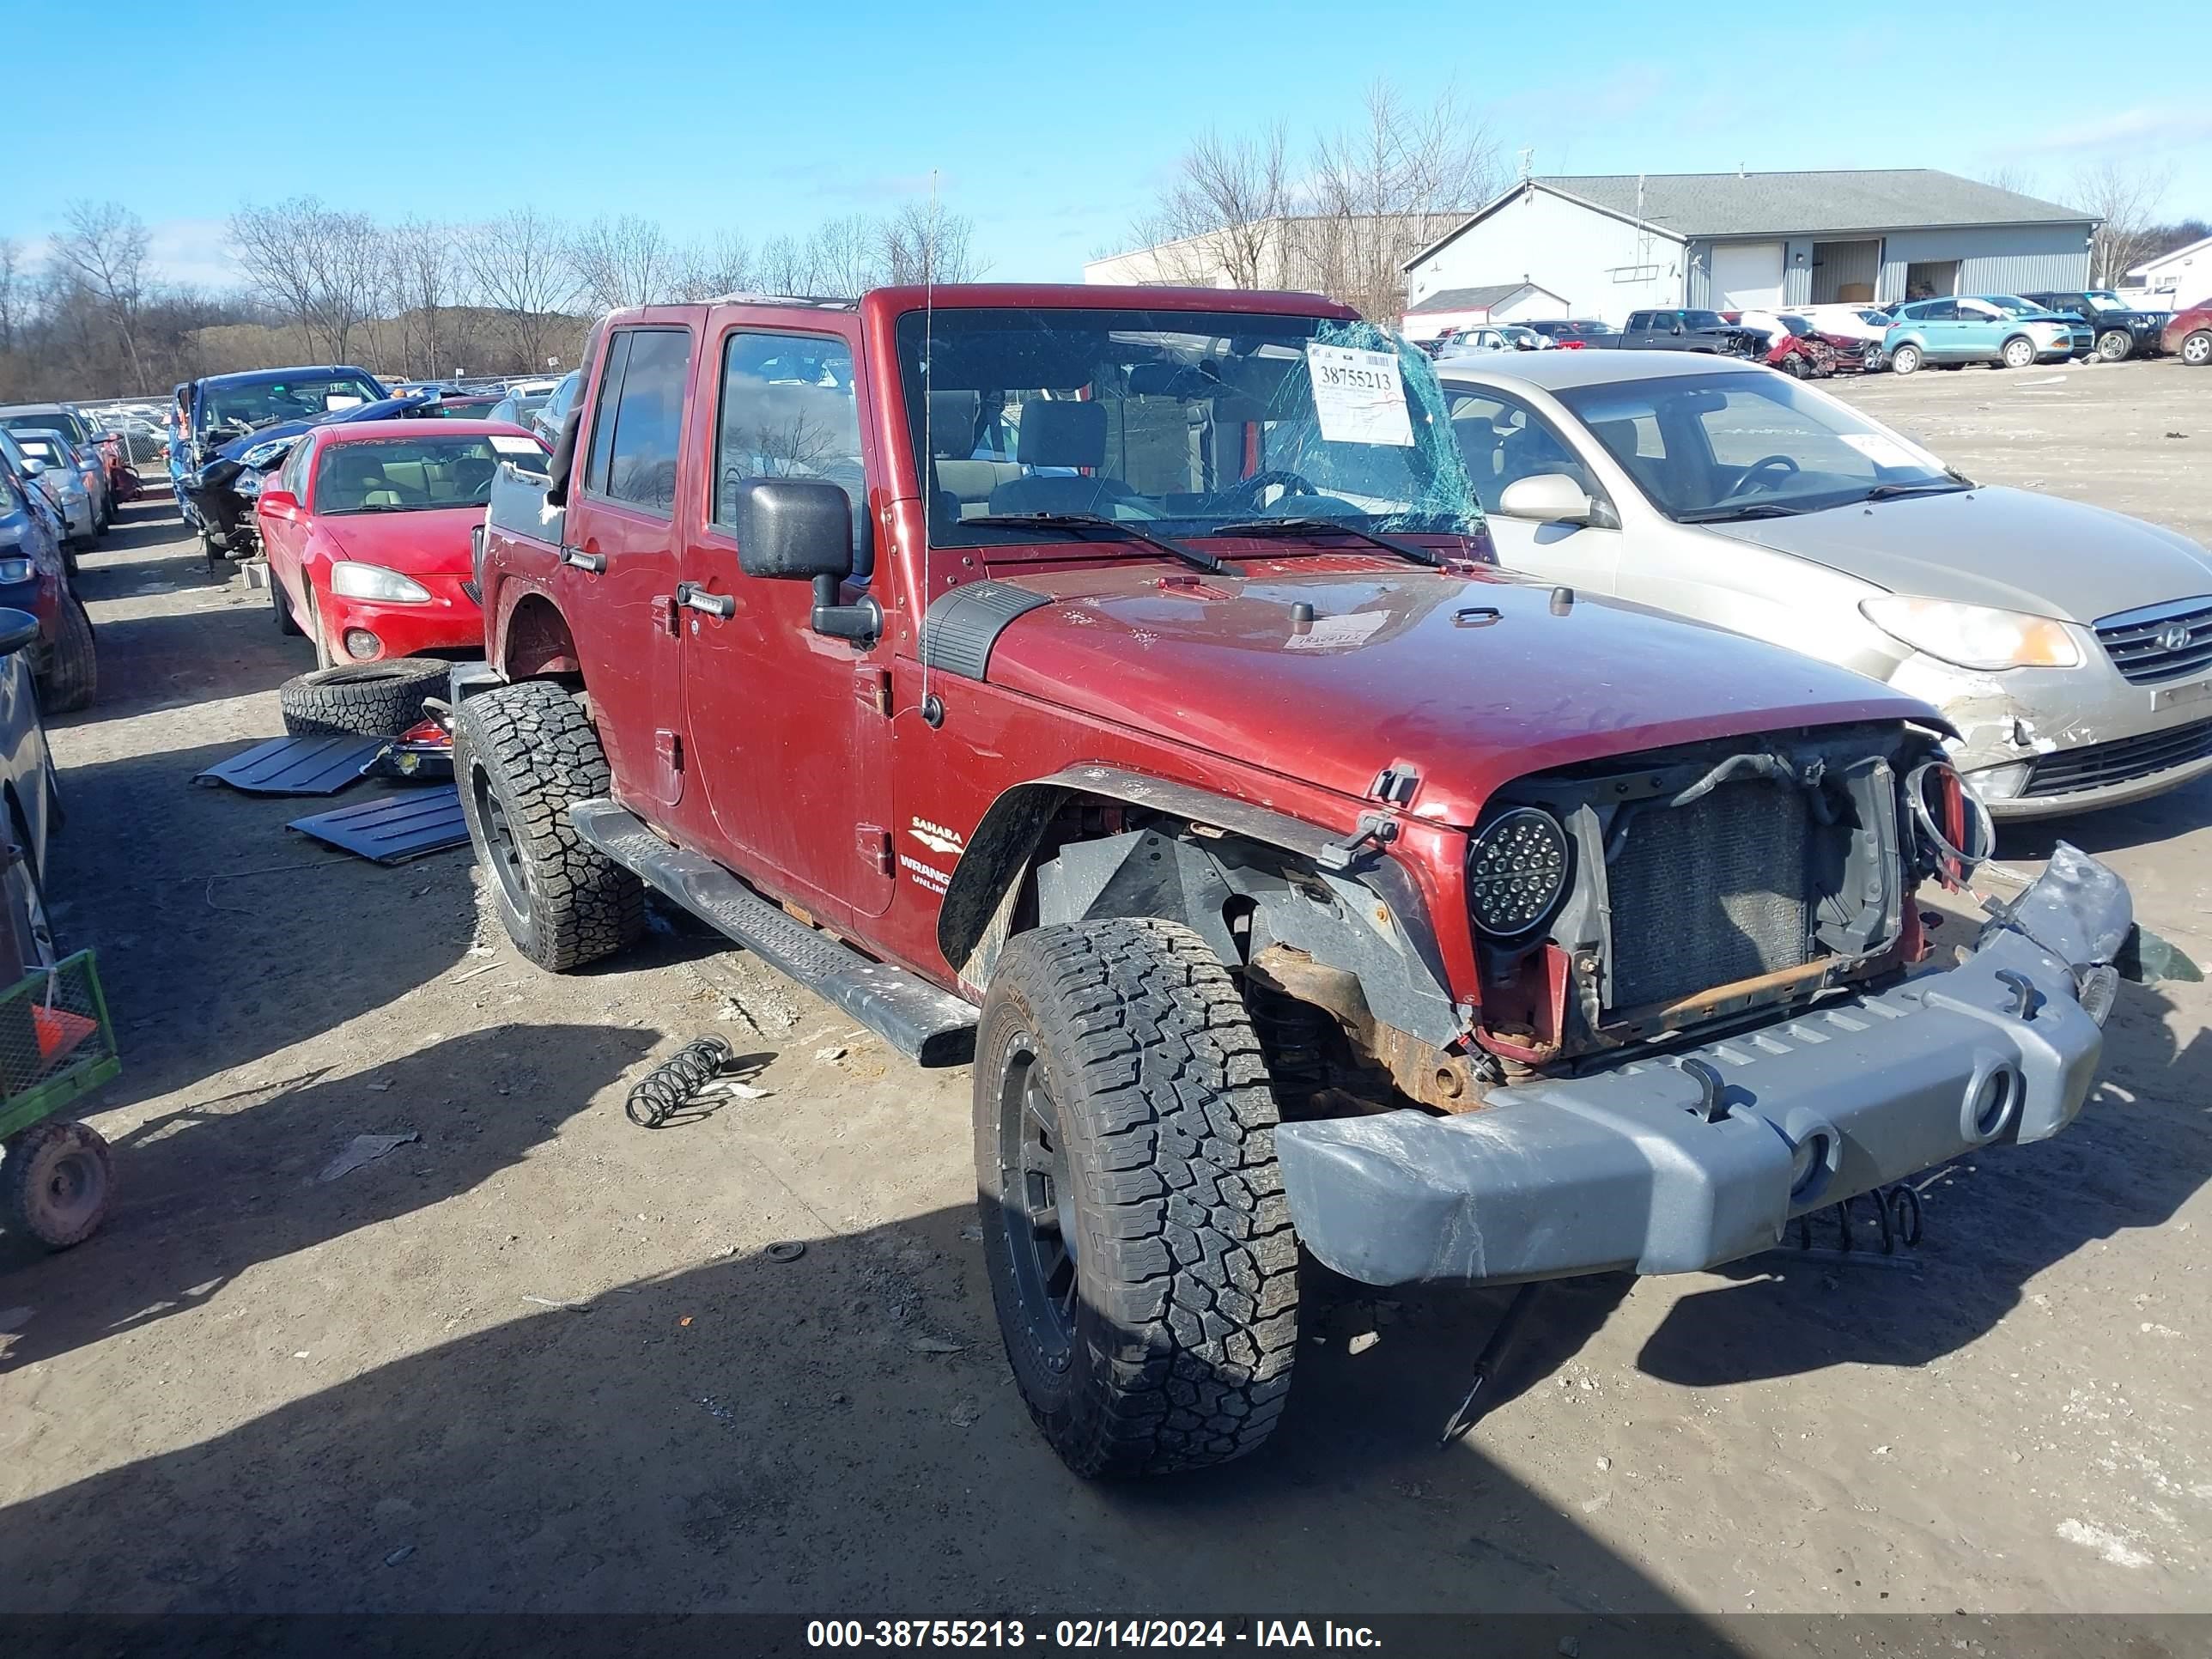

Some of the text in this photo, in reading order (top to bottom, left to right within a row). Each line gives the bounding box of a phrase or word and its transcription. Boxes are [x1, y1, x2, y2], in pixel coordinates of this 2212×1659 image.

[1321, 365, 1391, 390] 38755213
[912, 816, 963, 844] SAHARA
[899, 854, 951, 884] WRANG
